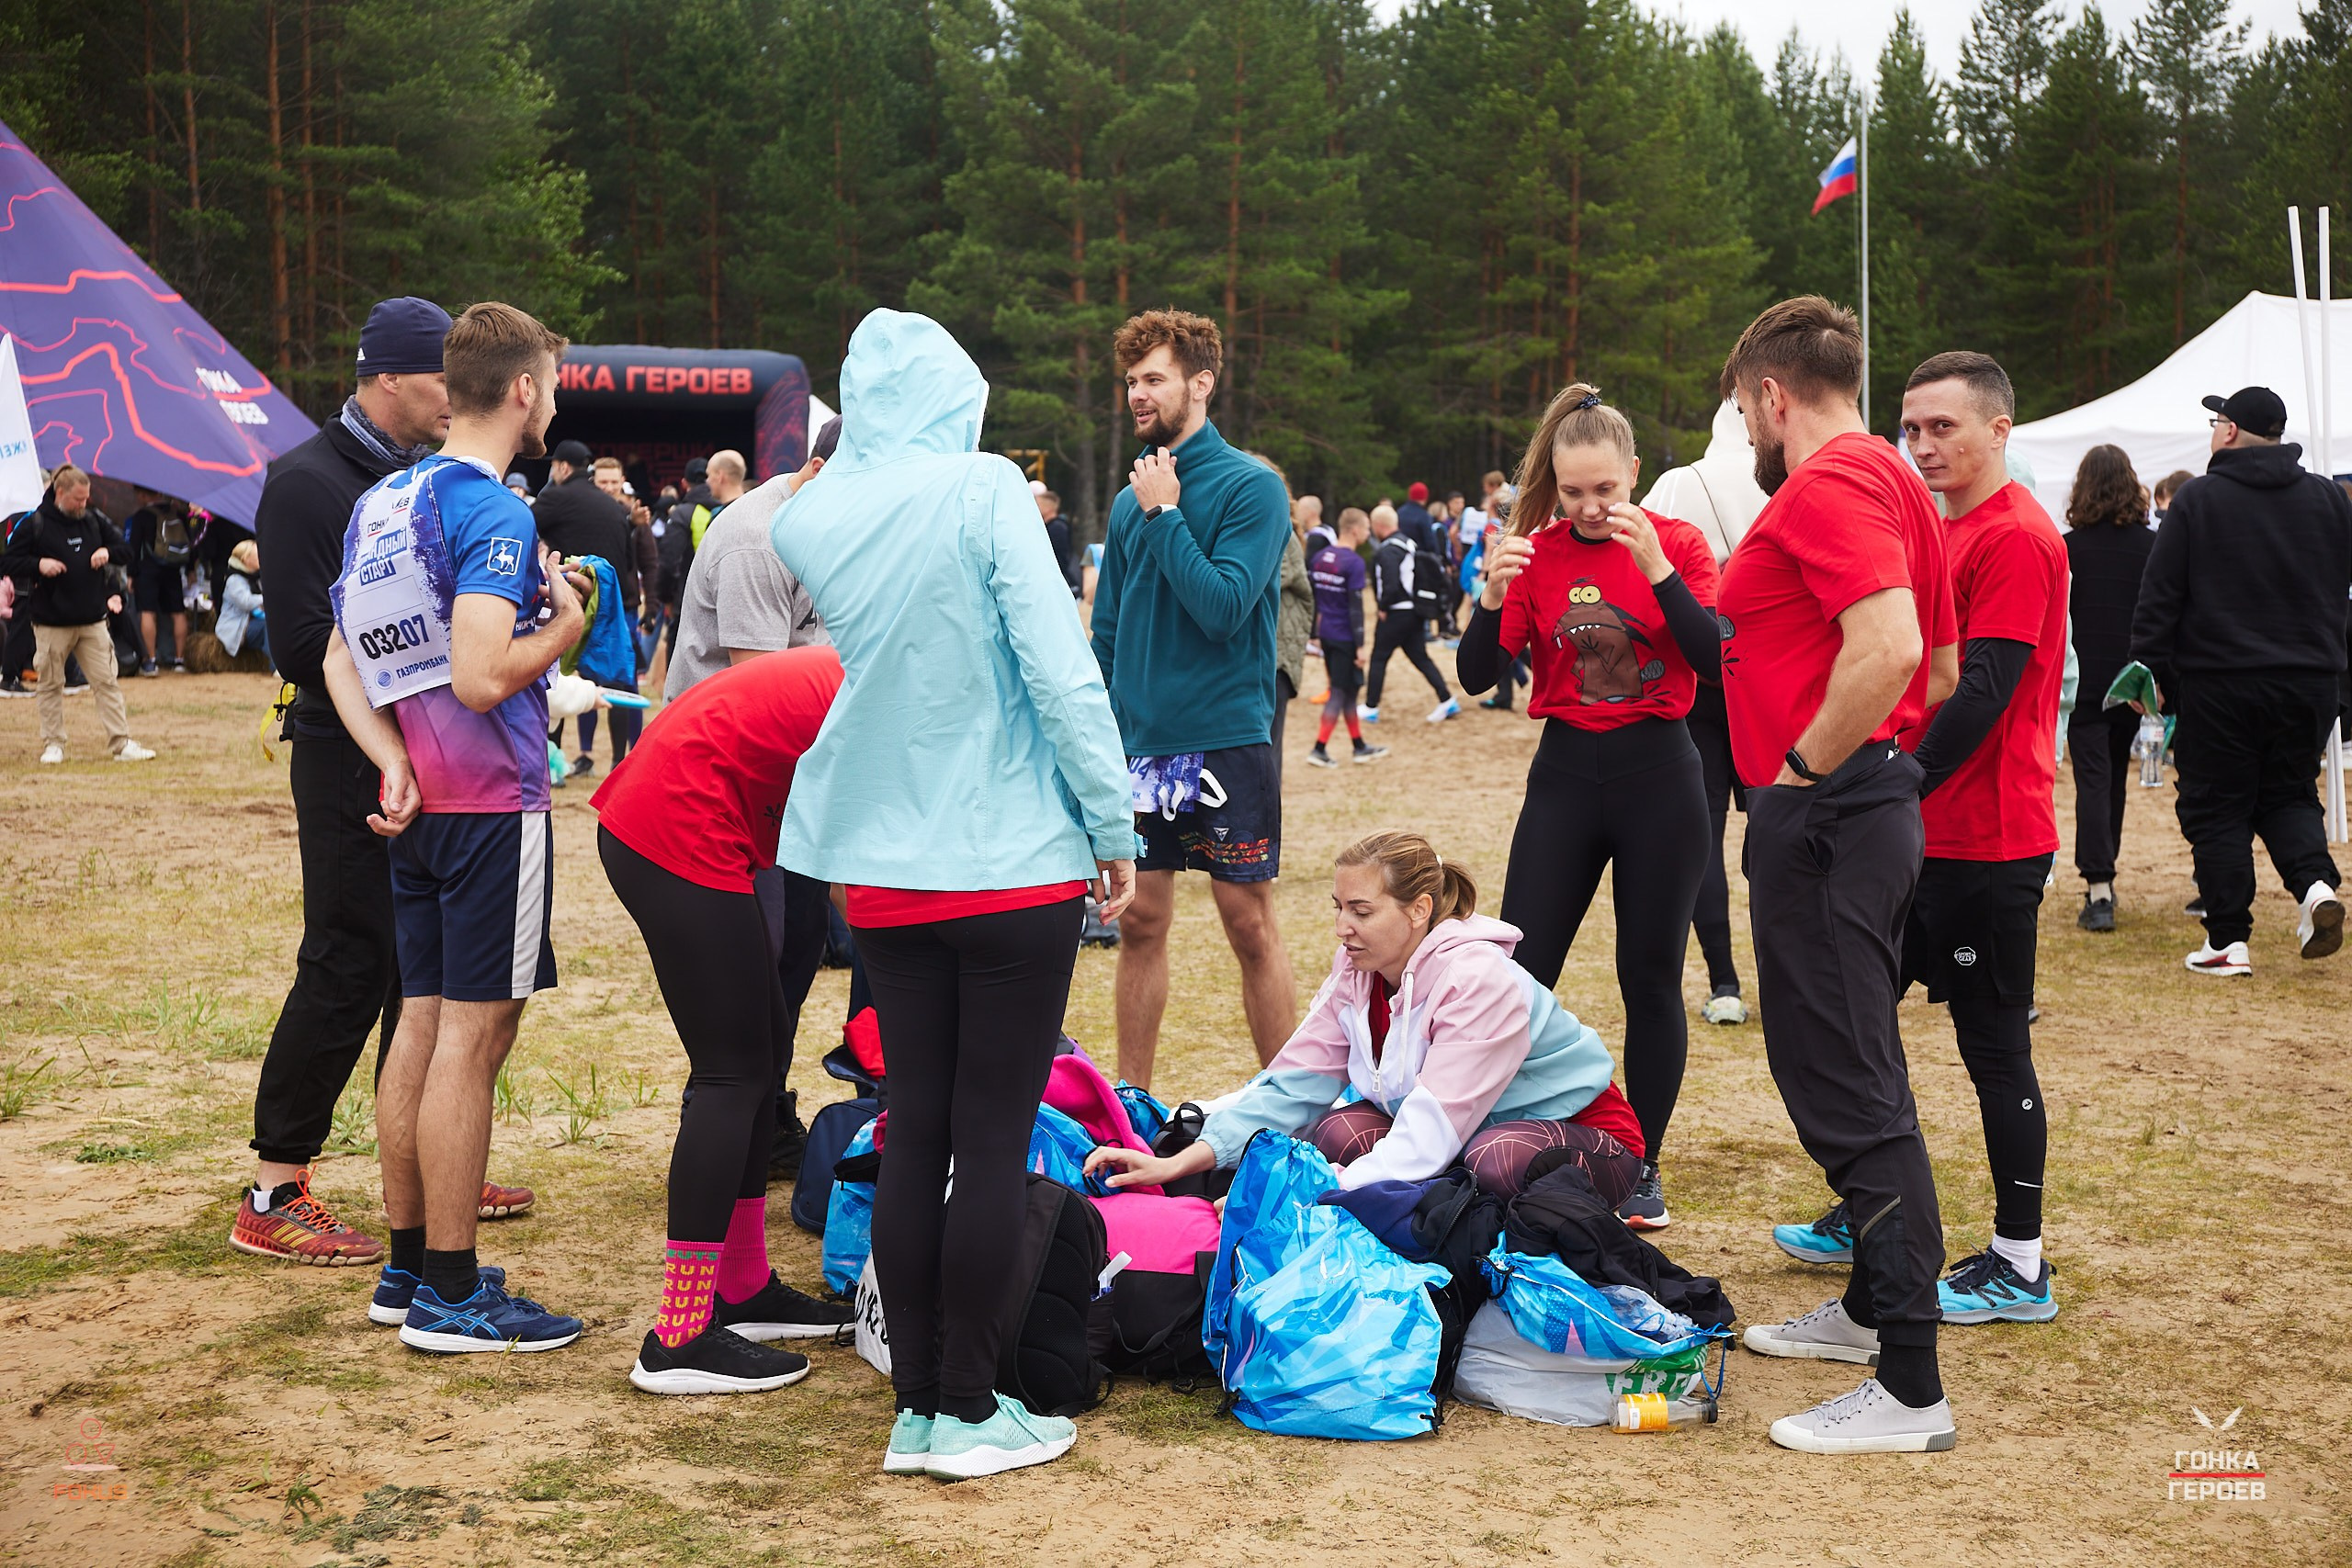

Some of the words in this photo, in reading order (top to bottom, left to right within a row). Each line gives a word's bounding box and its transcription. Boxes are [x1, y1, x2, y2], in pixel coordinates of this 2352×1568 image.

[558, 364, 616, 391] НКА
[626, 366, 752, 394] ГЕРОЕВ
[360, 557, 394, 584] СТАРТ
[358, 614, 430, 660] 03207
[396, 654, 449, 679] ГАЗПРОМБАНК
[665, 1262, 715, 1275] RUN
[664, 1278, 712, 1292] RUN
[662, 1294, 708, 1309] RUN
[657, 1309, 706, 1327] RUN
[658, 1324, 703, 1348] UN
